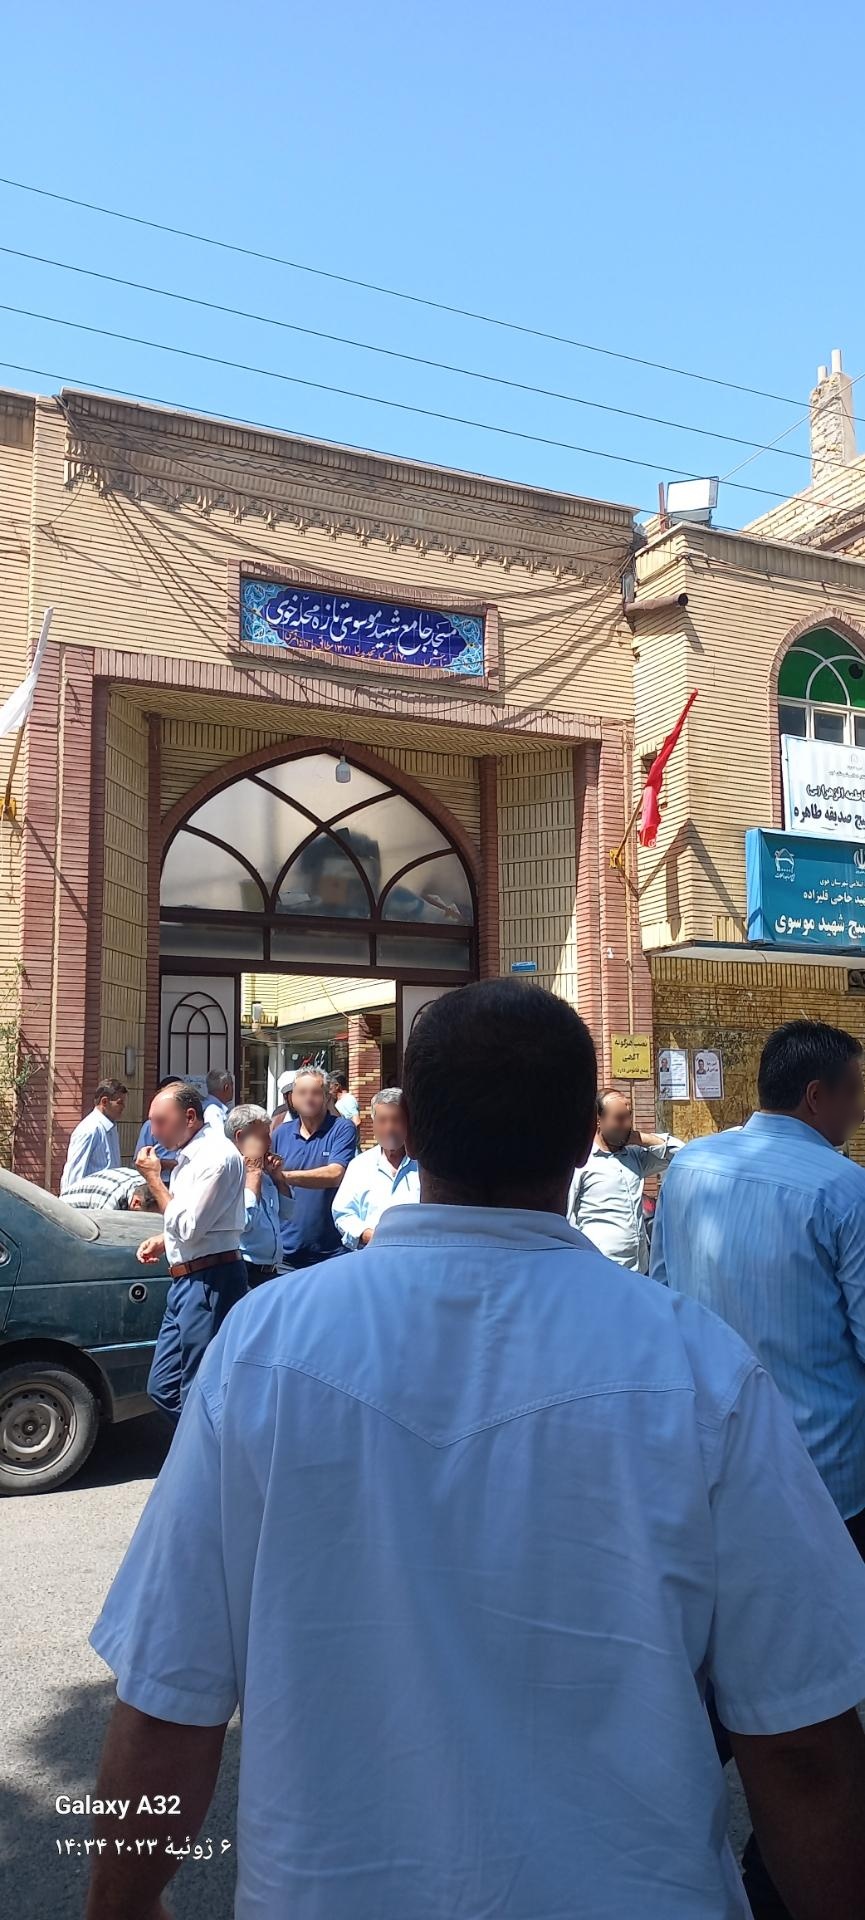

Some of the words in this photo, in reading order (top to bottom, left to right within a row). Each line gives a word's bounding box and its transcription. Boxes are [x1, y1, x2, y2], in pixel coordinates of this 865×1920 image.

[266, 594, 299, 626] خوی
[330, 609, 382, 643] موسوی
[366, 609, 400, 649] شهید
[398, 612, 434, 656] جامع
[423, 621, 457, 656] مسجد
[793, 803, 822, 823] طاهره
[824, 806, 852, 826] صدیقه
[830, 891, 852, 905] حاجی
[774, 914, 815, 936] موسوی
[818, 913, 845, 936] شهید
